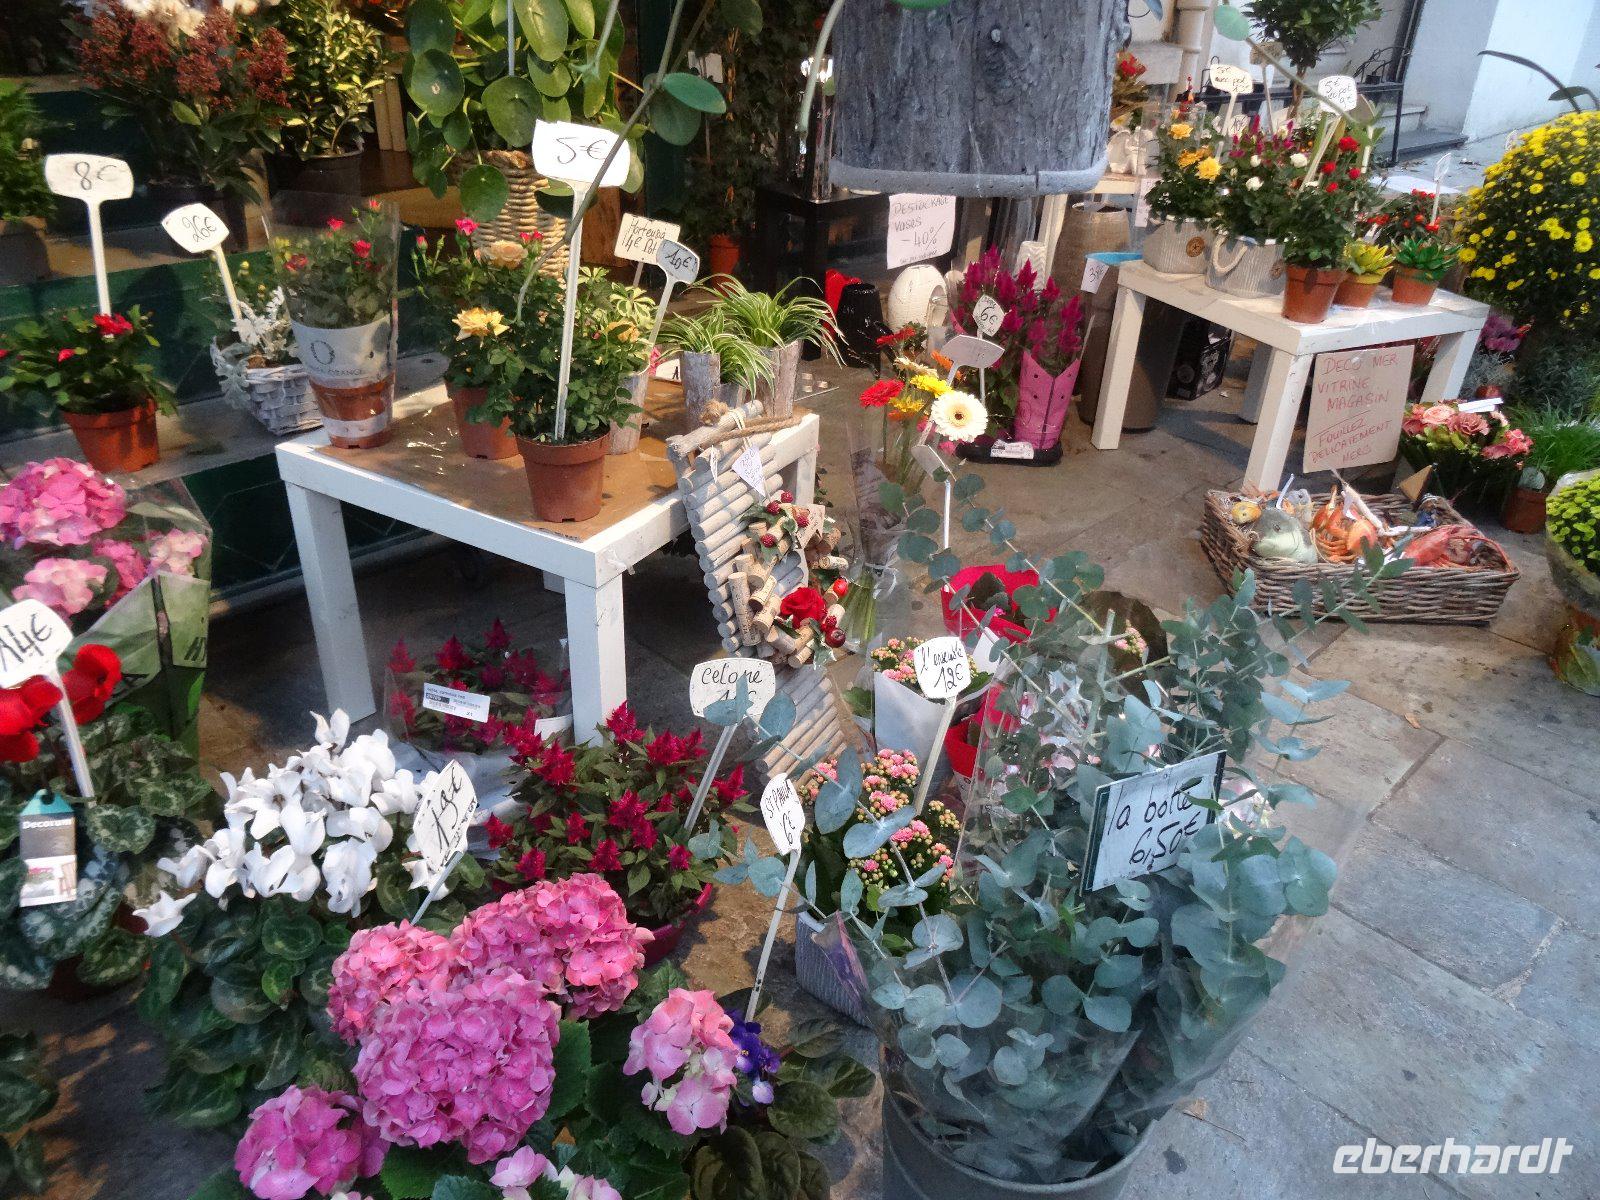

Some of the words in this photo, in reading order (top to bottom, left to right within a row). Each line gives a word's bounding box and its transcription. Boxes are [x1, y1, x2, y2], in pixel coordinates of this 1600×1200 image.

[75, 161, 117, 191] 8€
[1371, 352, 1399, 369] MER
[1317, 377, 1371, 394] VITRINE
[1326, 389, 1390, 413] MAGASIN
[1107, 784, 1132, 836] la
